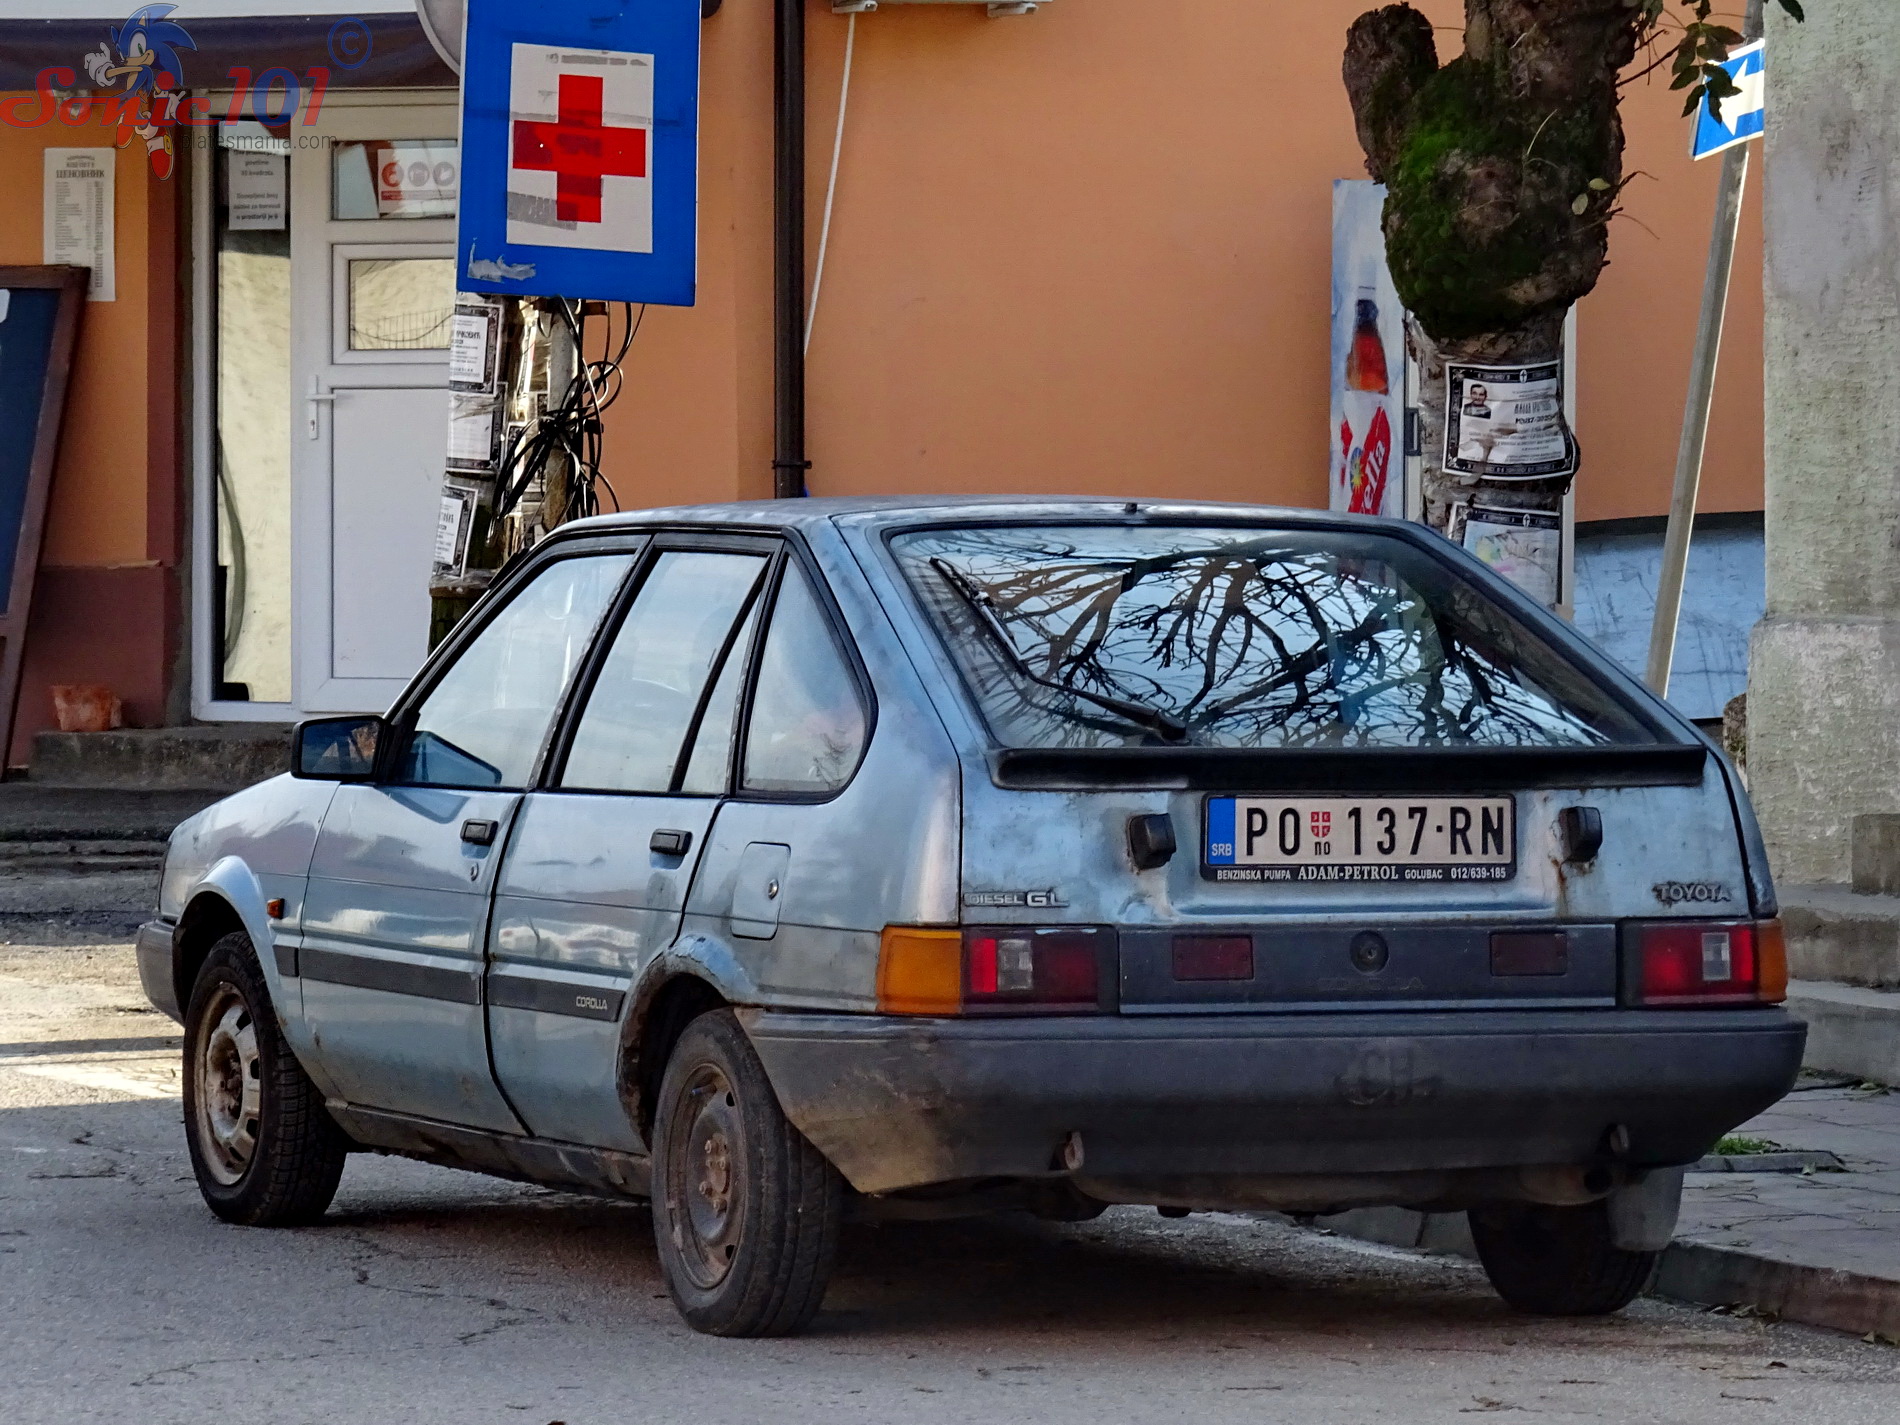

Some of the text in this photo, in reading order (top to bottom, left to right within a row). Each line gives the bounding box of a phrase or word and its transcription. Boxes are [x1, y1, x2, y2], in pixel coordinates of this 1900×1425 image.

[1246, 807, 1300, 856] PO
[1211, 843, 1232, 857] SRB
[1217, 865, 1507, 881] BENZINSKA PUMPA ADAM-PETROL GOLUBAC 012/639-185
[969, 891, 1070, 908] DIESEL GL
[1655, 884, 1732, 901] TOYOTA
[575, 996, 608, 1010] COROLLA
